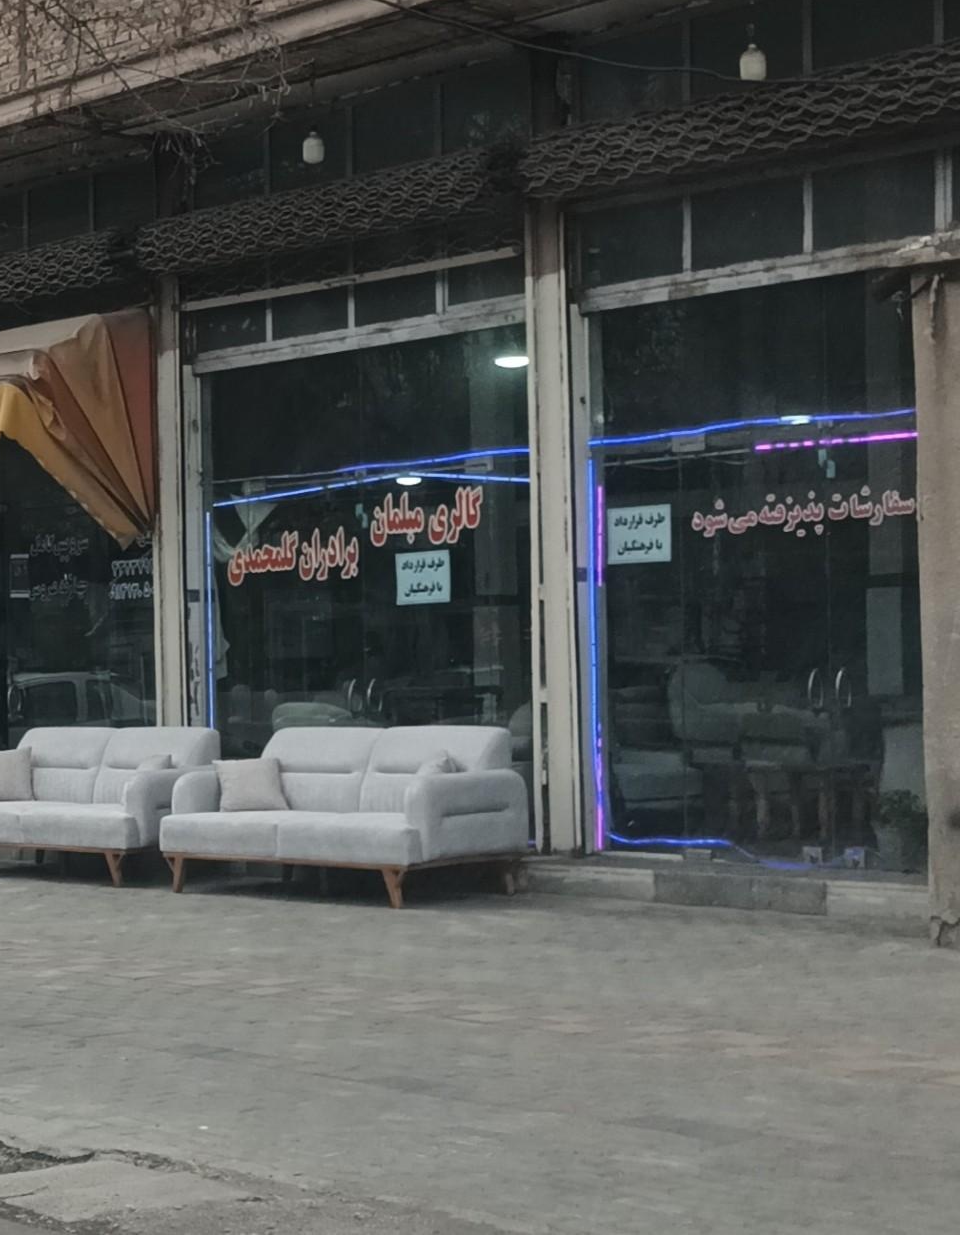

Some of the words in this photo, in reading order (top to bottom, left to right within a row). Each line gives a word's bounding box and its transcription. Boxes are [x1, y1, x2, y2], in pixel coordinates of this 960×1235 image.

[370, 491, 425, 546] مبلمان
[428, 486, 483, 545] گالری
[645, 511, 665, 528] طرف
[757, 490, 825, 537] پذیرفته
[828, 485, 916, 527] سفارشات
[299, 526, 359, 581] برادران
[427, 557, 445, 572] طرف
[617, 538, 654, 556] فرهنگیان
[655, 539, 663, 551] با
